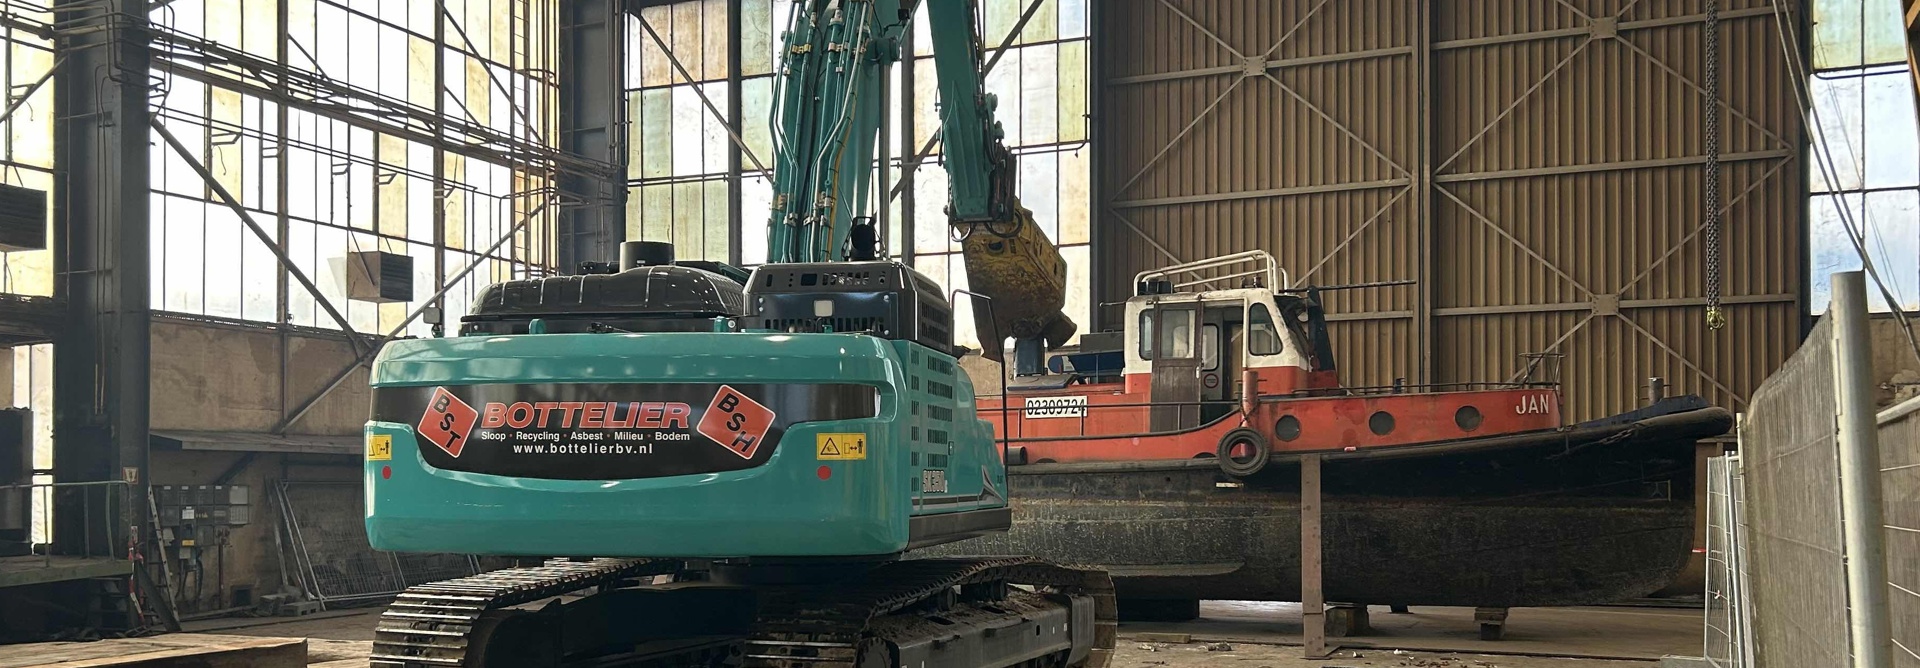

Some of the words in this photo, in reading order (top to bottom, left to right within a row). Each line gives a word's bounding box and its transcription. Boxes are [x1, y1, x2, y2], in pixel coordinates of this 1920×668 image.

[481, 401, 691, 429] BOTTELIER
[1027, 398, 1086, 416] 02309724
[1515, 393, 1549, 415] JAN
[433, 394, 461, 448] BST
[717, 393, 756, 453] BSH
[481, 431, 507, 442] Sloop
[516, 431, 560, 442] Recycling
[570, 431, 603, 441] Asbest
[614, 431, 644, 441] Milieu
[655, 431, 690, 441] Bodem
[513, 443, 653, 454] www.bottelierbv.nl
